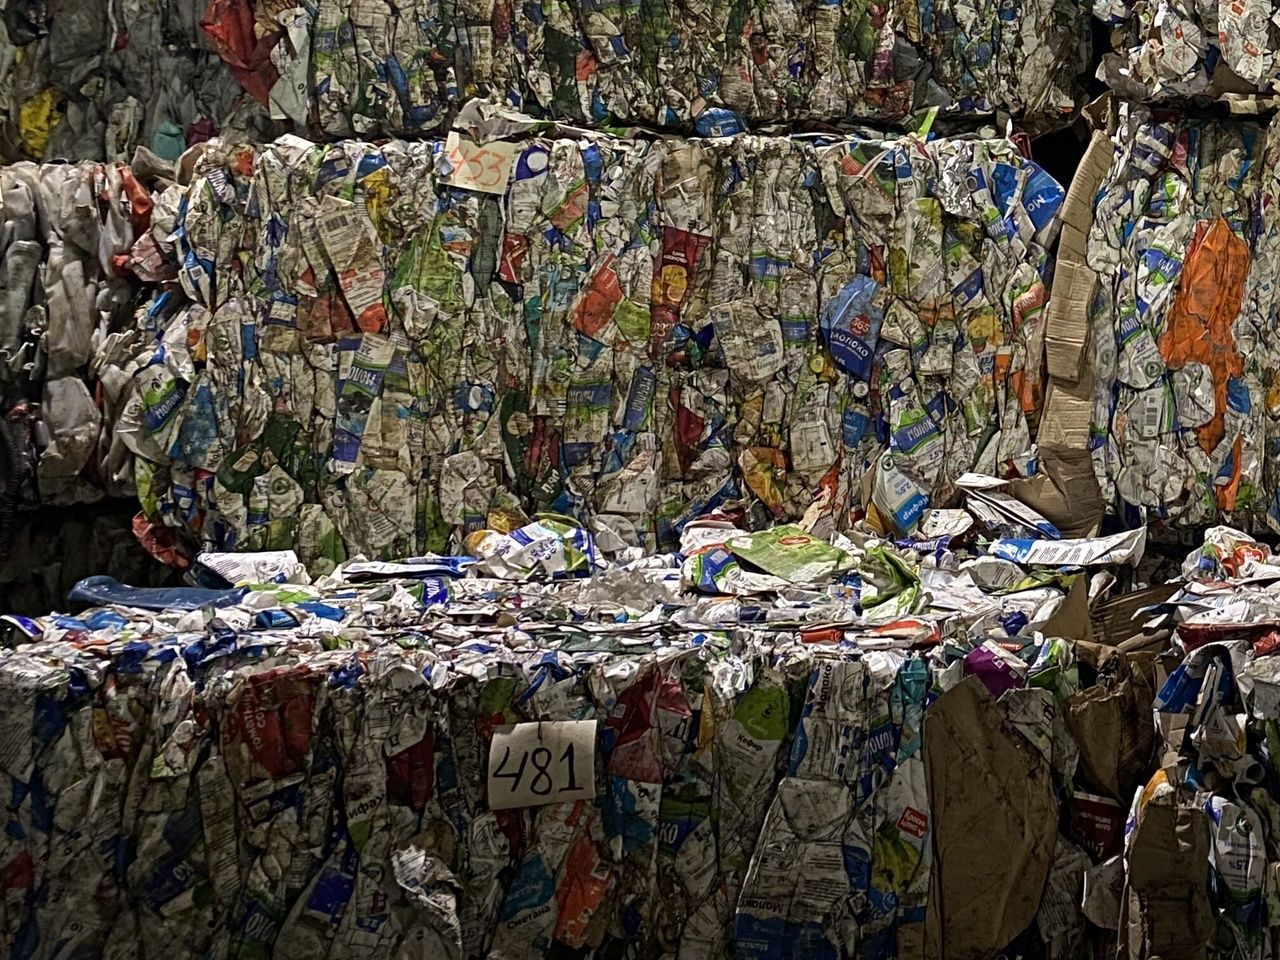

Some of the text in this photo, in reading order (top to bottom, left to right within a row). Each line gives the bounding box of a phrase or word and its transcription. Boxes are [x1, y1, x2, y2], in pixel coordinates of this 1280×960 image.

[451, 147, 506, 186] 453
[851, 316, 871, 332] 365
[829, 328, 871, 358] МОЛОКО
[152, 387, 187, 420] МОЛОКО
[899, 493, 931, 522] Кефир
[735, 732, 763, 752] Кефир
[492, 742, 585, 796] 481
[504, 902, 553, 932] Сметана
